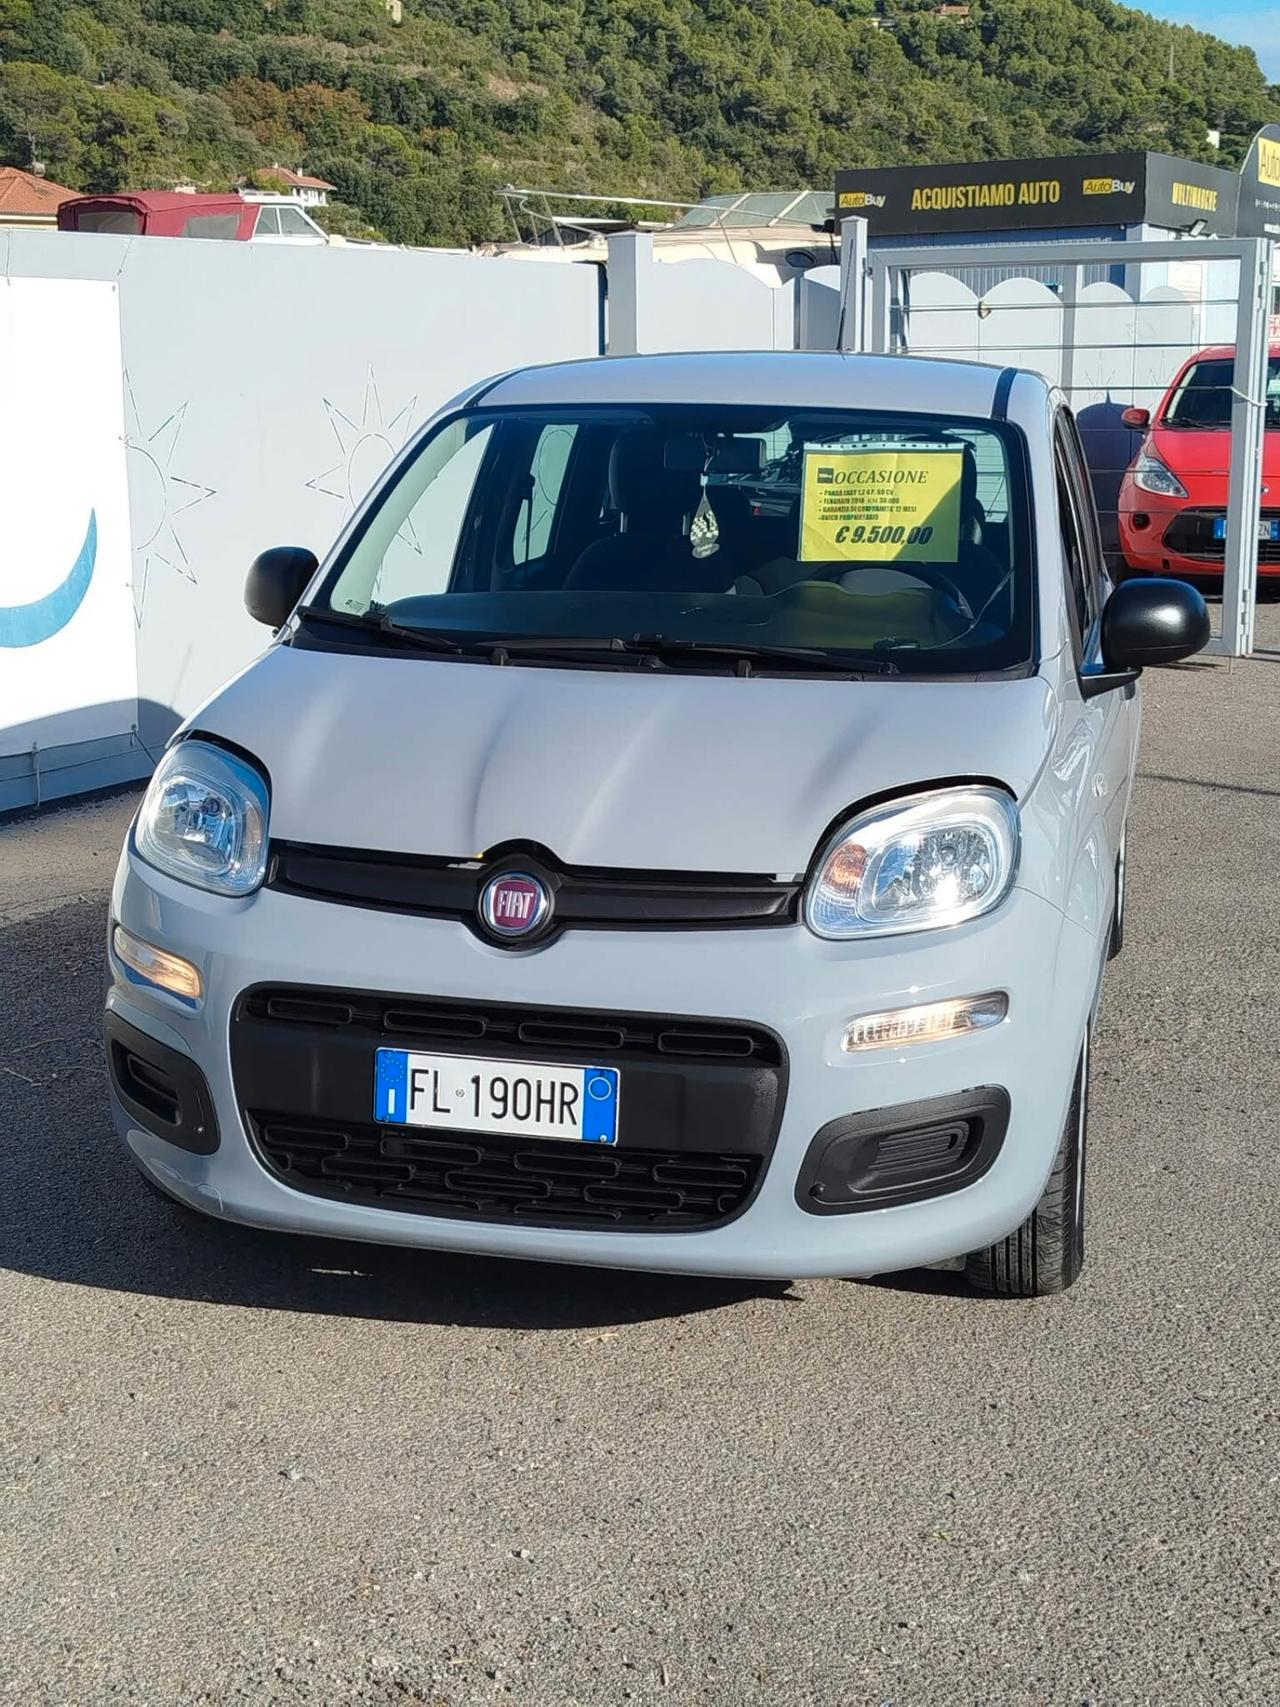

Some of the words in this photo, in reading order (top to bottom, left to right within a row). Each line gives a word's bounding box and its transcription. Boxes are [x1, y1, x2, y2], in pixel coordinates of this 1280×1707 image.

[911, 184, 1015, 210] ACQUISTIAMO
[1018, 180, 1061, 205] AUTO
[1084, 179, 1135, 194] AutoBuy
[840, 193, 886, 208] AutoBuy
[834, 470, 929, 484] OCCASIONE
[835, 526, 849, 544] €
[850, 526, 934, 545] 9.500,00
[496, 889, 535, 919] FIAT
[409, 1068, 451, 1114] FL
[470, 1074, 580, 1126] 190HR
